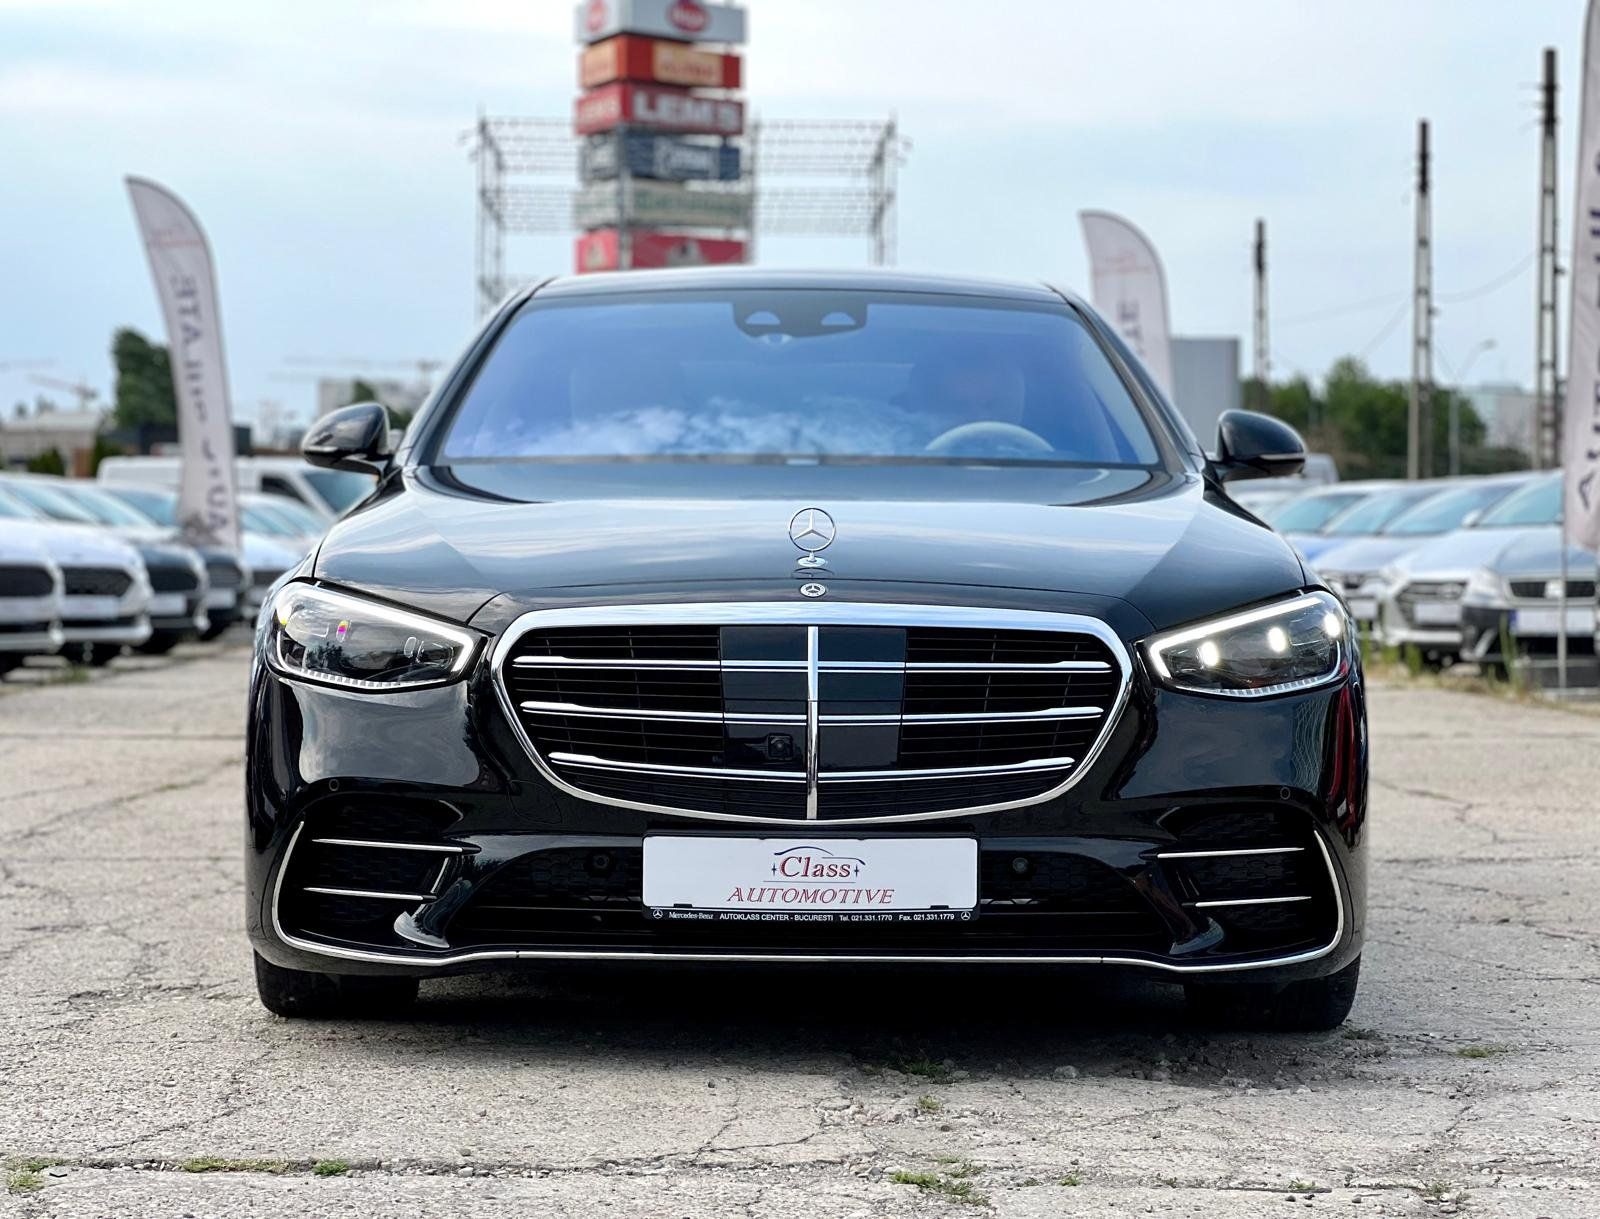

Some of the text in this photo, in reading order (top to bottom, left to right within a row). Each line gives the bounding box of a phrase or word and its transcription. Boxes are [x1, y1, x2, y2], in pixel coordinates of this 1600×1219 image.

[780, 856, 850, 877] Class
[727, 887, 894, 904] AUTOMOTIVE
[669, 911, 713, 920] Mercedes-Benz
[719, 913, 760, 921] AUTOKLASS
[761, 914, 789, 922] CENTER
[794, 914, 833, 922] BUCURESTI
[851, 914, 893, 922] 021.331.1770
[899, 914, 911, 922] Fax.
